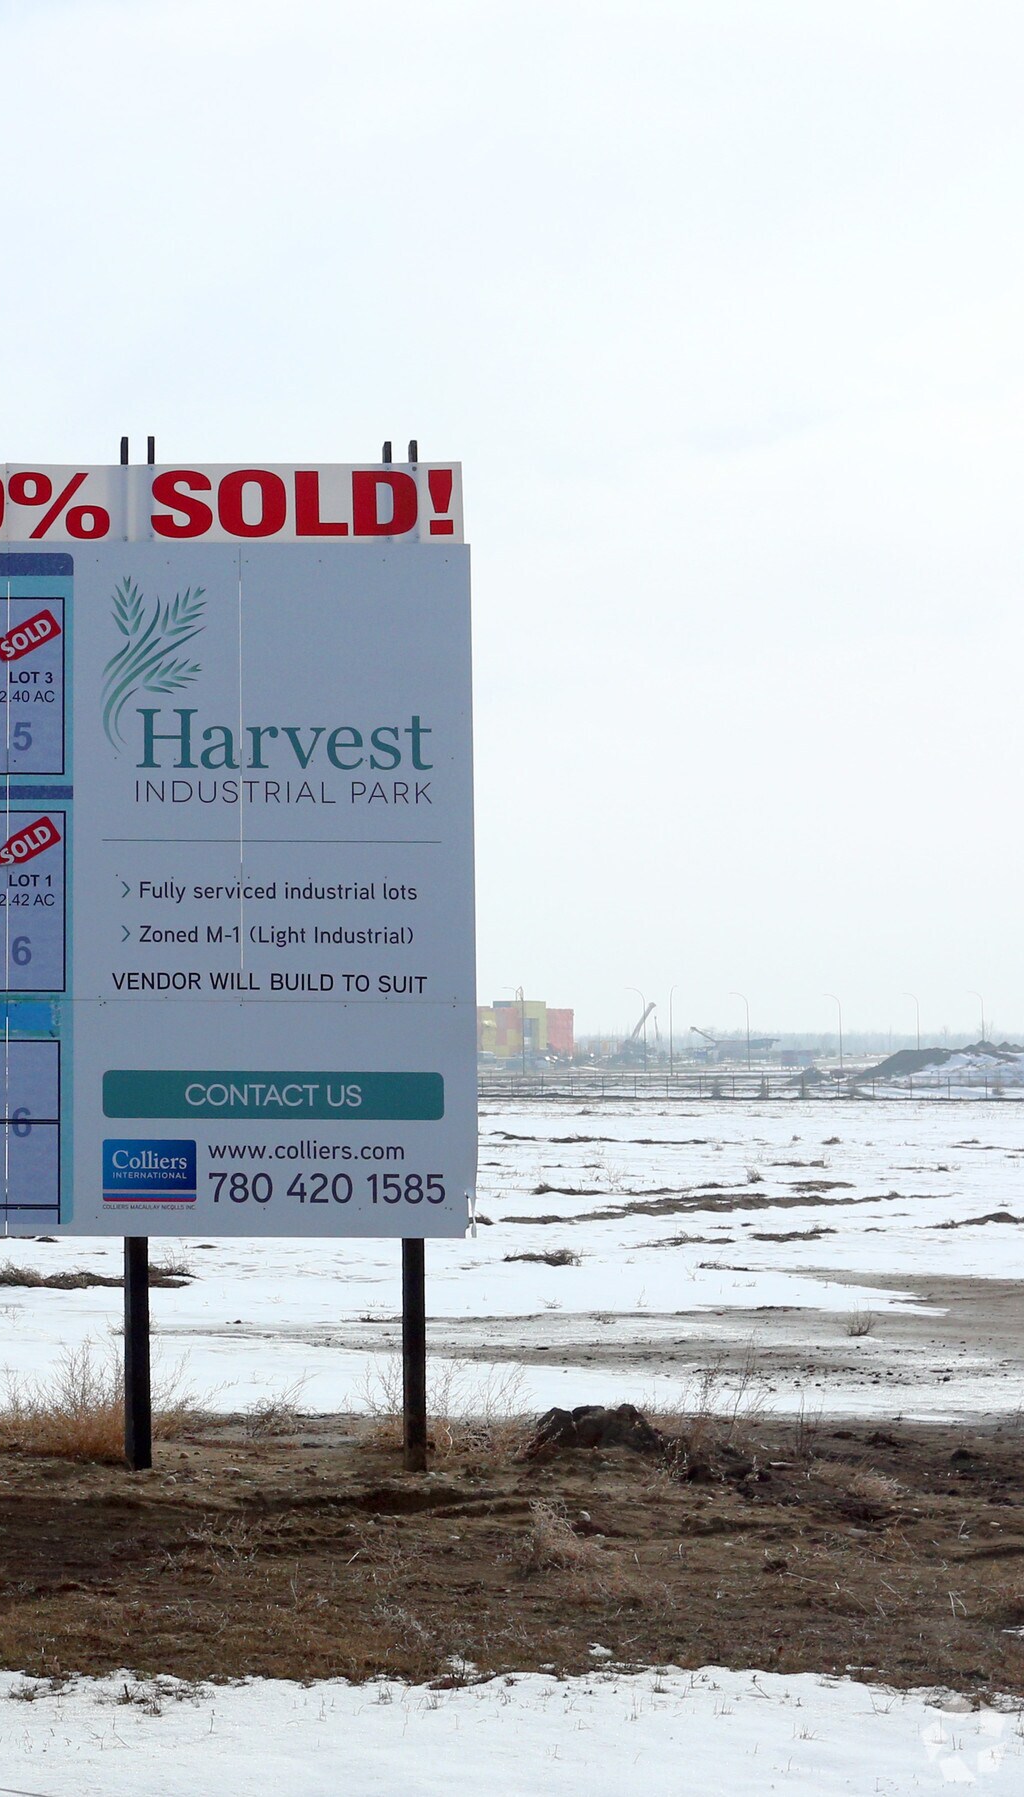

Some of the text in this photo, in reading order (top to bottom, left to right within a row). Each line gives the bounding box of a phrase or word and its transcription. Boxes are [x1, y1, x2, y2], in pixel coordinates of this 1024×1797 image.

[151, 469, 453, 539] SOLD!
[0, 619, 52, 658] SOLD
[9, 671, 53, 684] LOT 3
[34, 690, 55, 703] AC
[13, 722, 33, 751] 5
[136, 708, 433, 770] Harvest
[135, 780, 433, 804] INDUSTRIAL PARK
[0, 826, 51, 866] SOLD
[9, 874, 51, 887] LOT 1
[139, 881, 417, 903] Fully serviced industrial lots
[33, 893, 55, 906] AC
[139, 926, 414, 947] Zoned M-1 (Light Industrial)
[12, 935, 32, 966] 6
[112, 972, 428, 994] VENDOR WILL BUILD TO SUIT
[185, 1083, 362, 1107] CONTACT US
[12, 1107, 32, 1138] 6
[112, 1150, 187, 1169] Colliers
[208, 1140, 405, 1161] www.colliers.com
[208, 1172, 446, 1205] 780 420 1585
